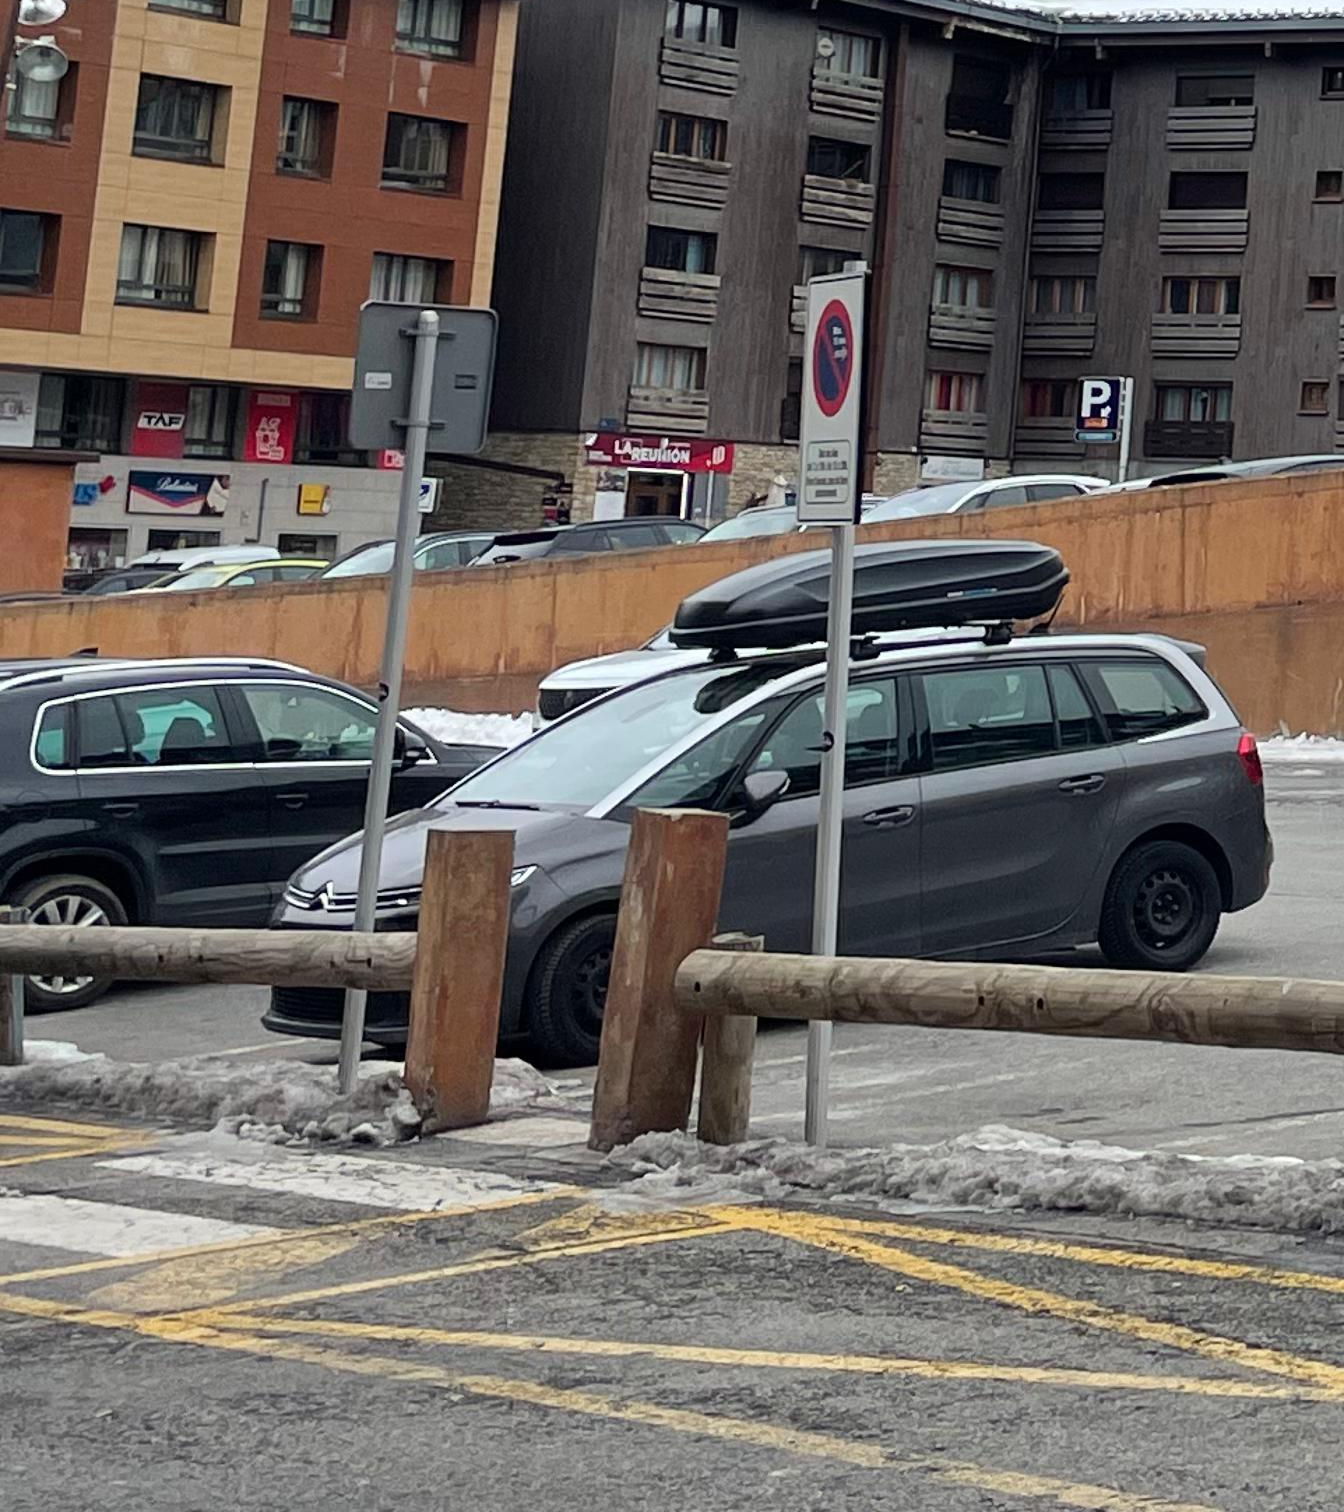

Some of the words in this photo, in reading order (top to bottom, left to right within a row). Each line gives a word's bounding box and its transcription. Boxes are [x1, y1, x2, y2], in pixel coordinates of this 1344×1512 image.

[1081, 380, 1112, 417] P
[143, 409, 181, 427] TAF
[614, 439, 632, 454] LA
